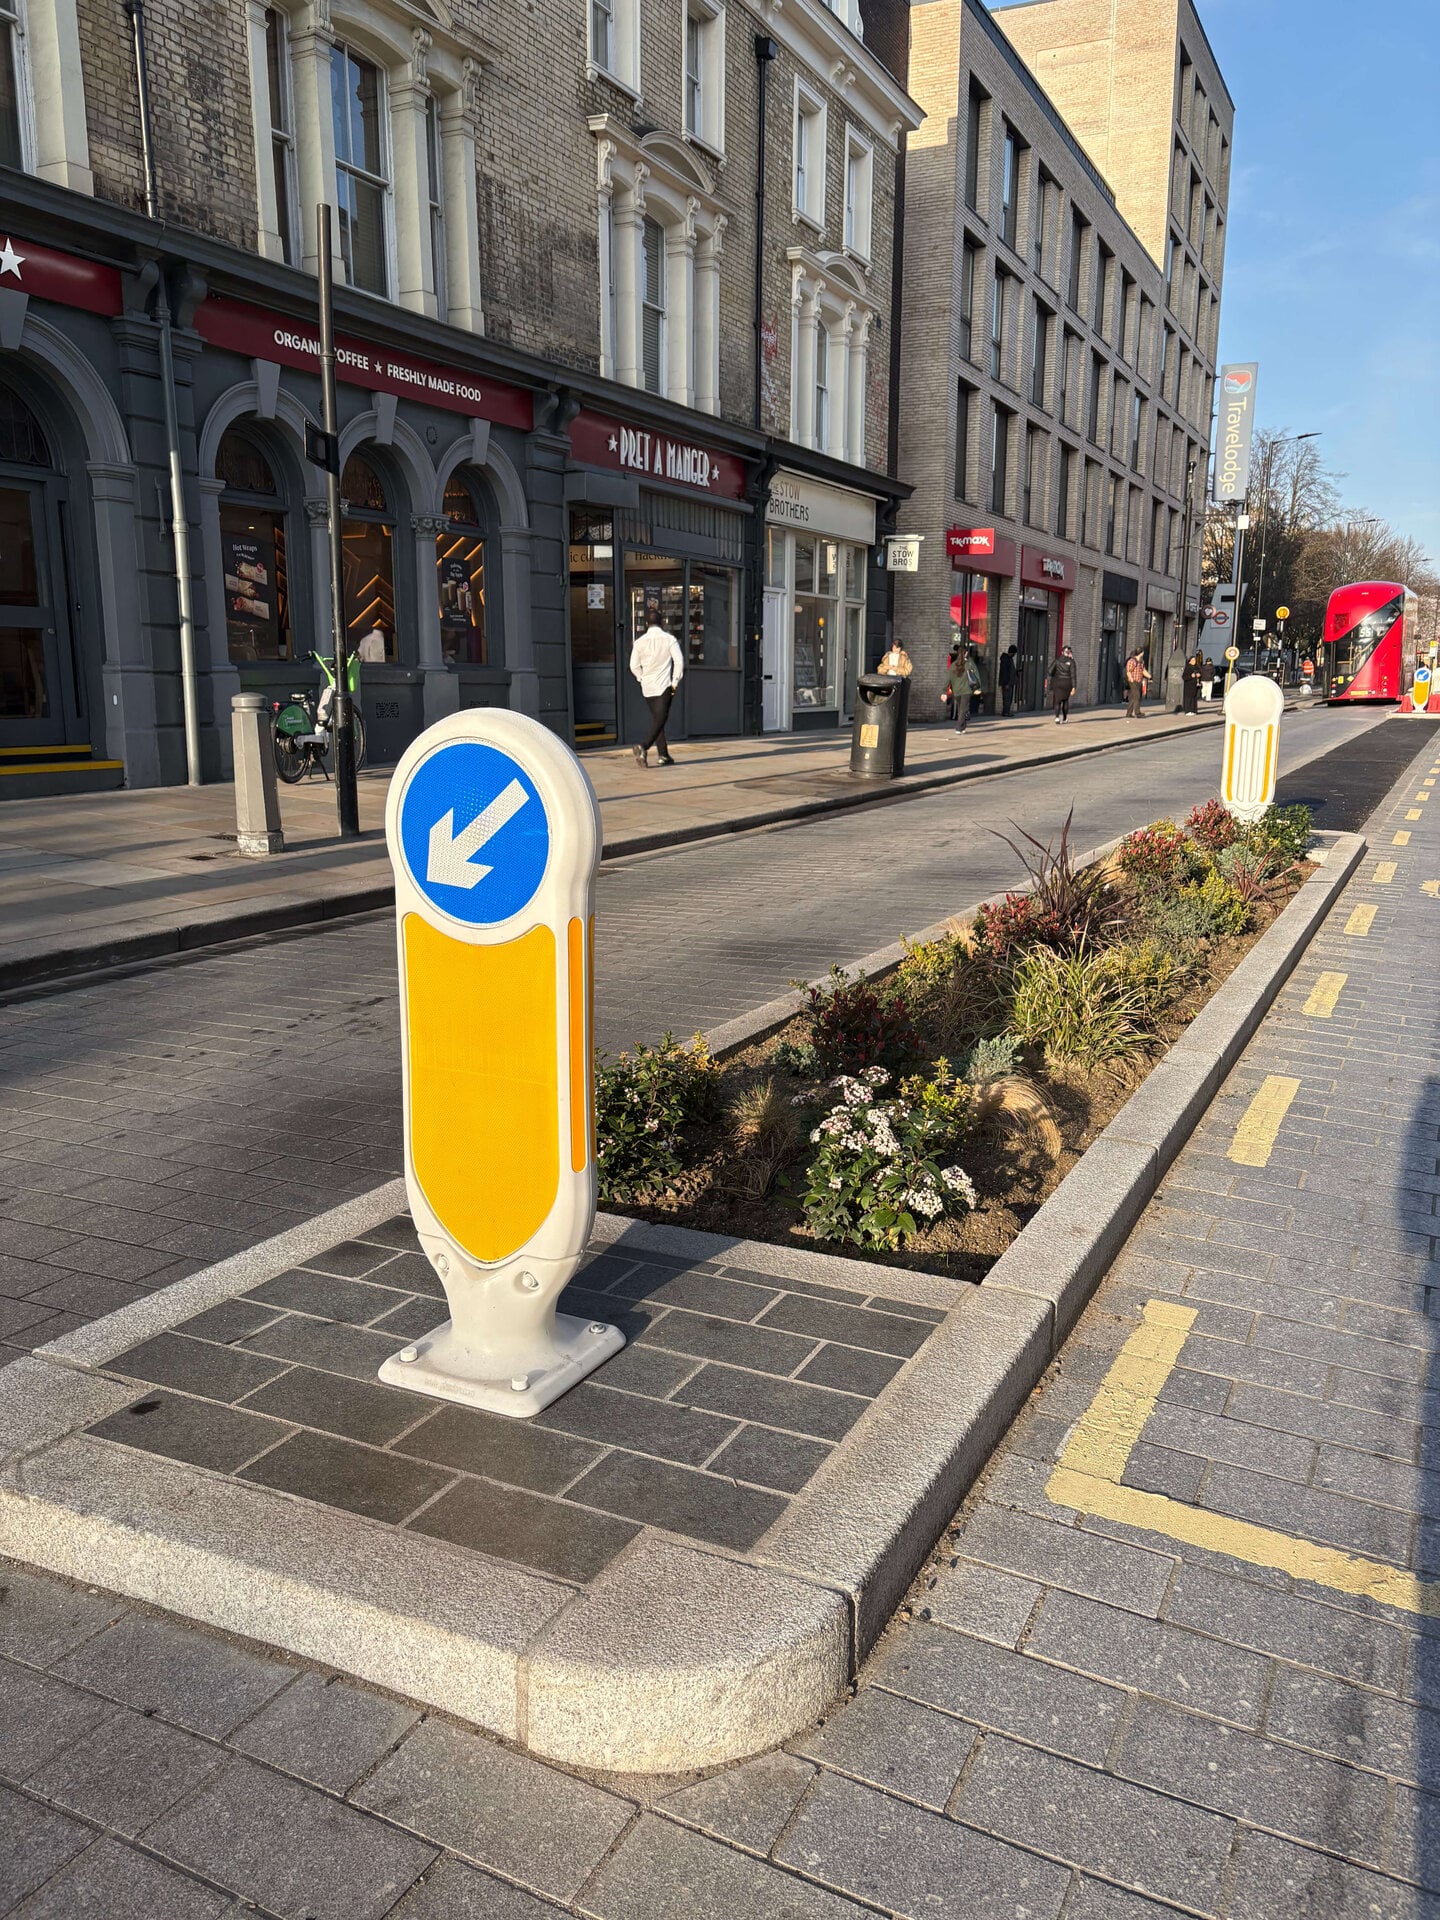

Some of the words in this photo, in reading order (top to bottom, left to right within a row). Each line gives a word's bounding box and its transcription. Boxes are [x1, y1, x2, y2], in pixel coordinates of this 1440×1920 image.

[274, 330, 321, 357] ORGANI
[334, 347, 369, 371] OFFEE
[387, 363, 427, 387] FRESHLY
[428, 375, 455, 395] MADE
[456, 384, 481, 402] FOOD
[620, 426, 651, 472] PRET
[653, 438, 663, 475] A
[666, 441, 710, 488] MANGER
[1219, 396, 1248, 494] Travelodge
[780, 480, 800, 501] STOW
[769, 497, 809, 522] BROTHERS
[892, 550, 914, 558] STOW
[892, 558, 913, 566] BROS
